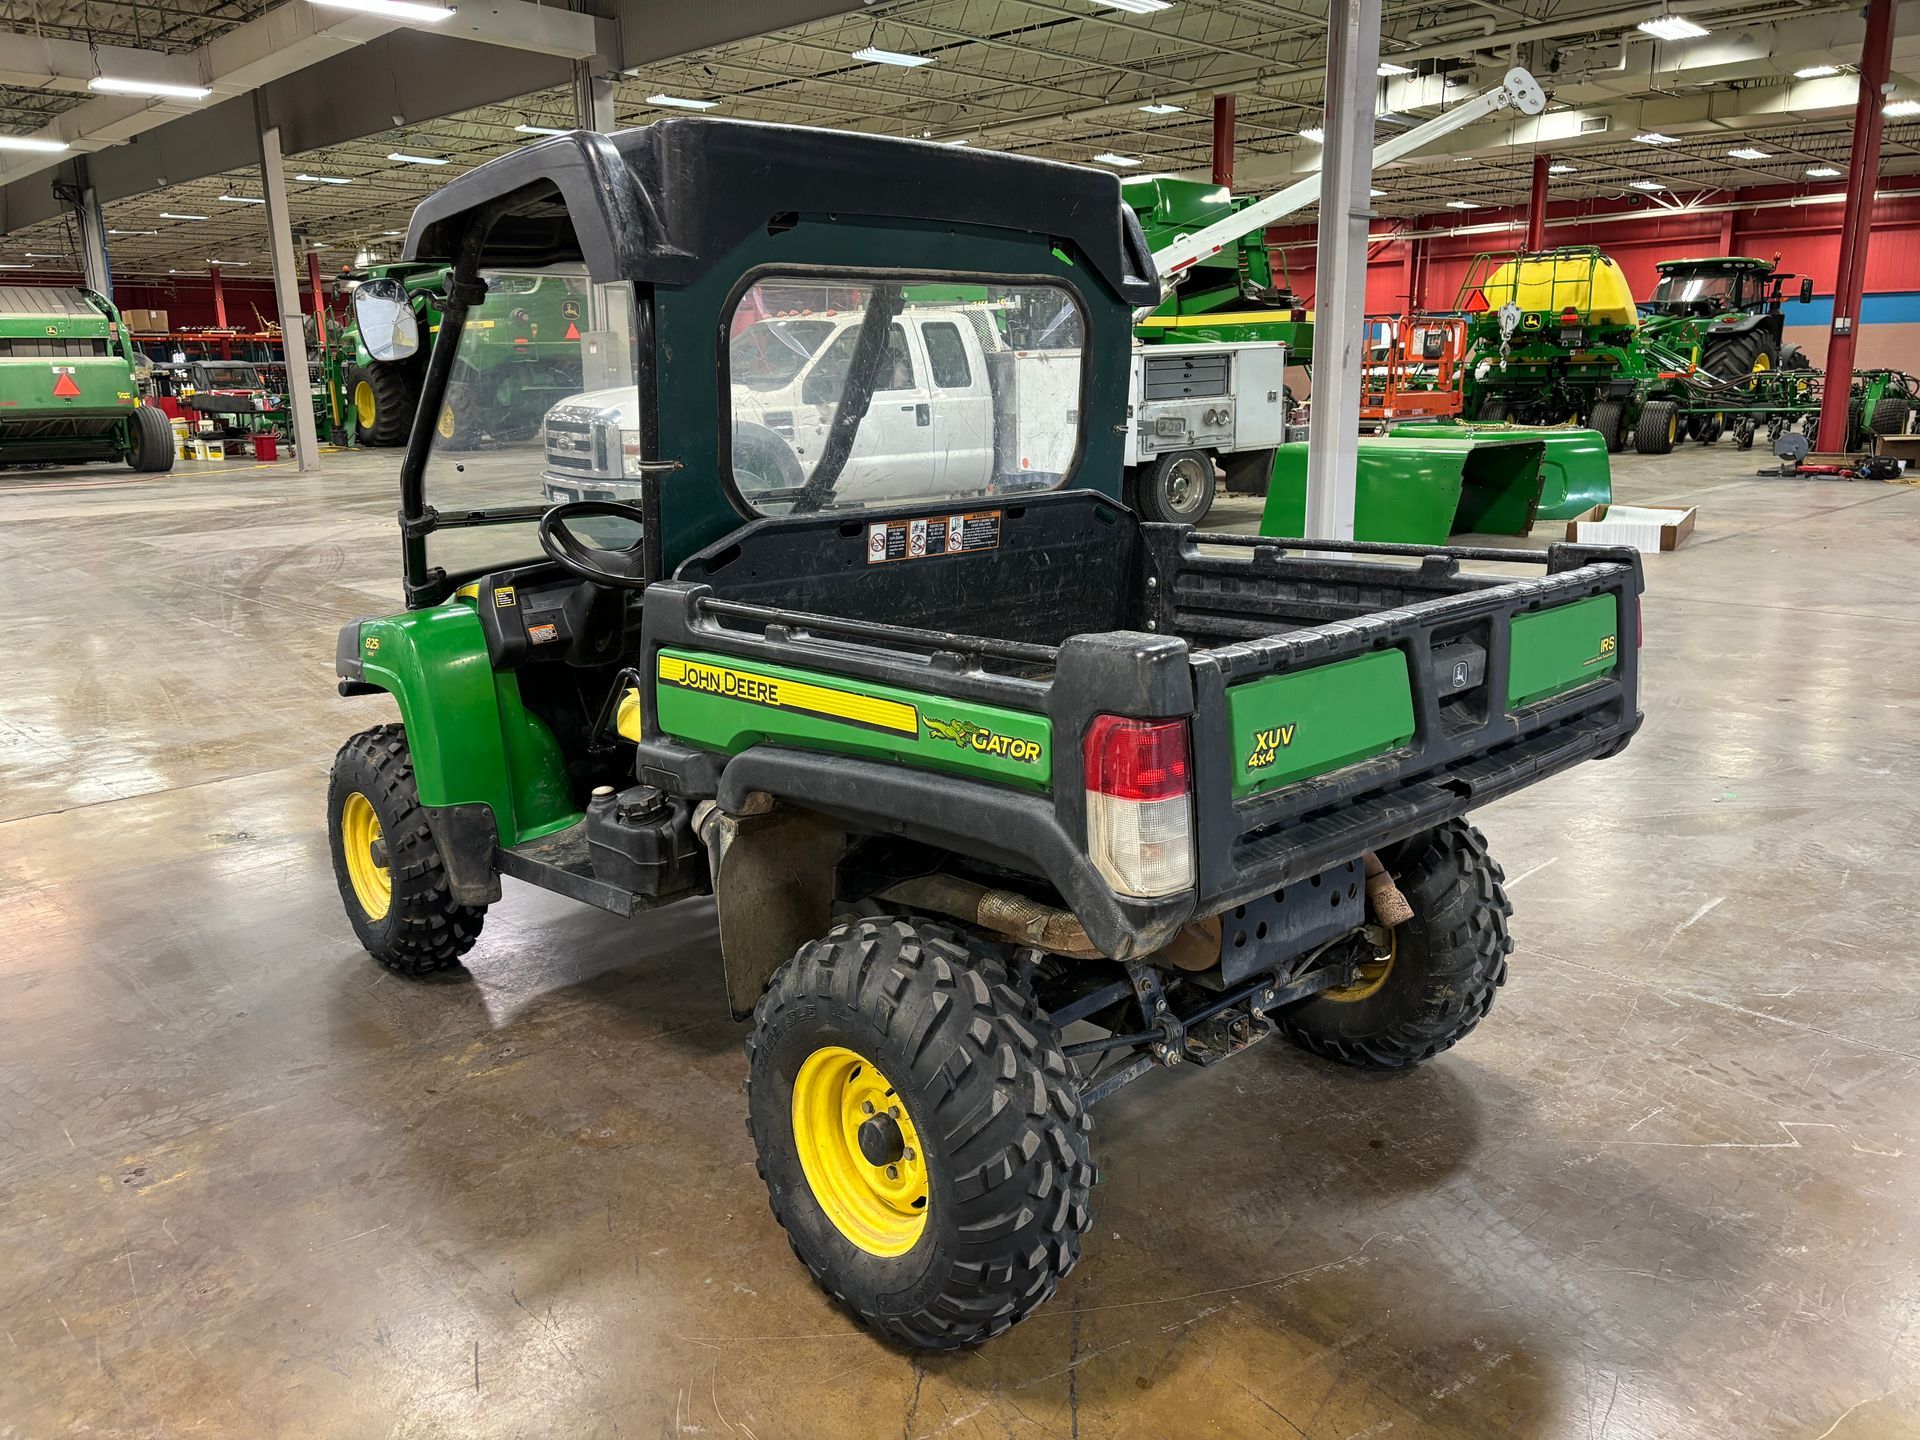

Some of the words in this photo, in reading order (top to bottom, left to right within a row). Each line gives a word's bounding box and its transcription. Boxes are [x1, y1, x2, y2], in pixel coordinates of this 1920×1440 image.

[1600, 635, 1616, 654] IRS
[679, 663, 721, 691] JOHN
[724, 671, 779, 703] DEERE
[971, 728, 1042, 762] GATOR
[1255, 724, 1296, 753] XUV
[1248, 748, 1276, 767] 4x4
